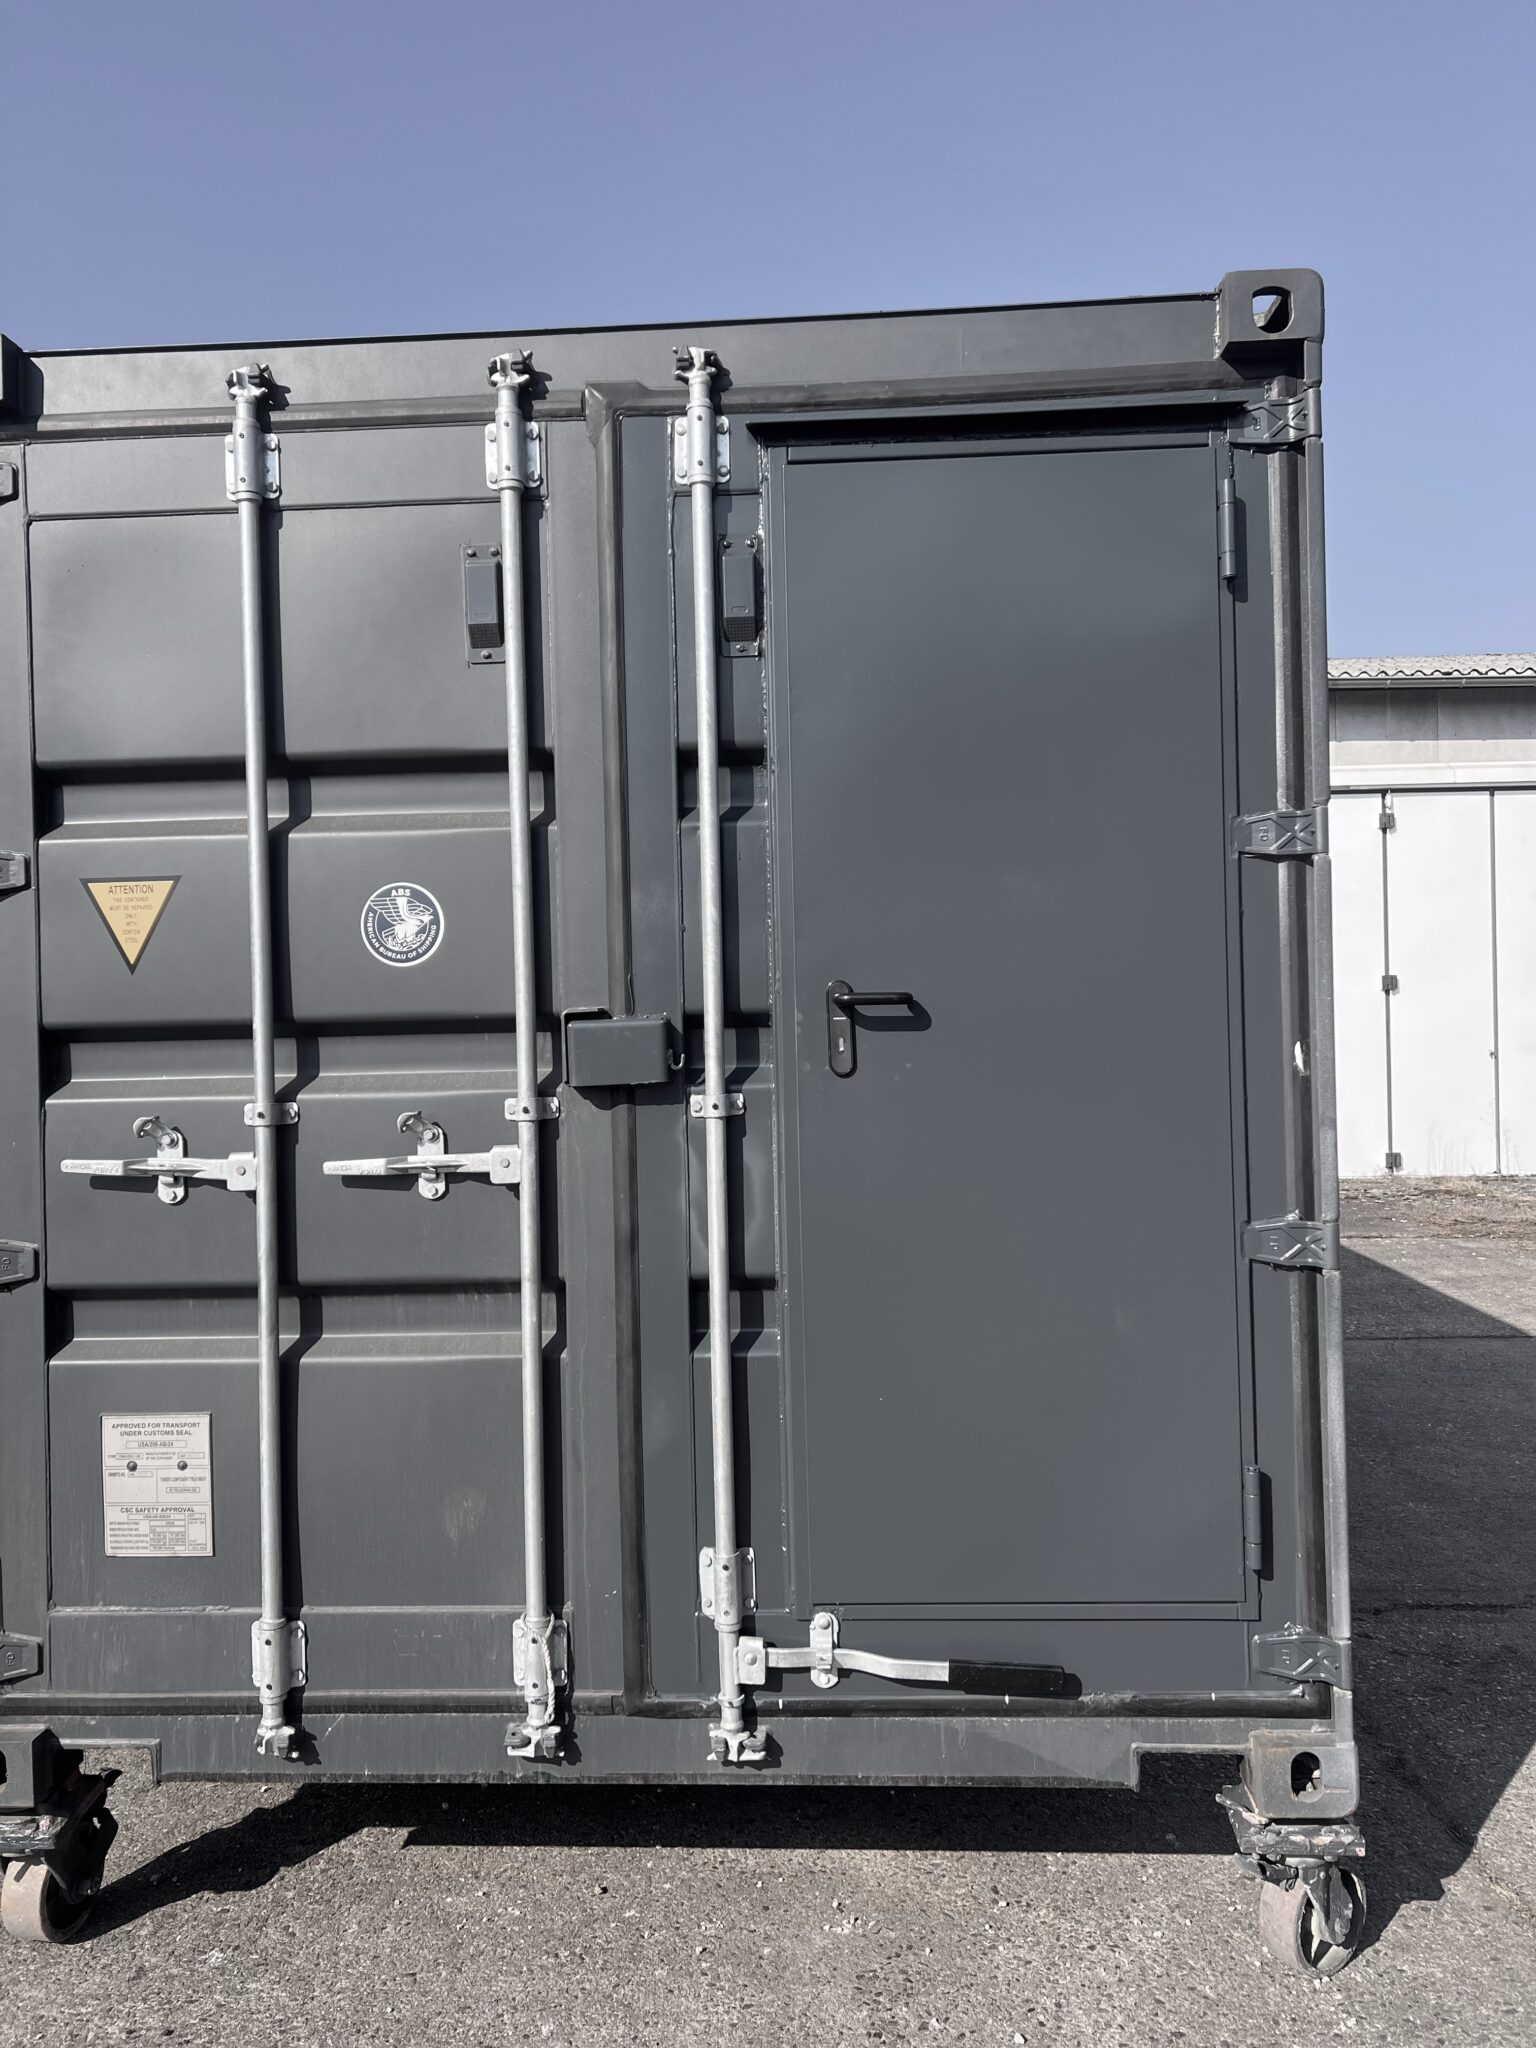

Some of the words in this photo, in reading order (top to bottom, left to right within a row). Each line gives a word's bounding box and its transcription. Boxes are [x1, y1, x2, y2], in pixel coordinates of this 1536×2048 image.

[108, 884, 154, 894] ATTENTION
[391, 888, 411, 896] ABS
[366, 912, 379, 948] AMERICAN
[378, 946, 407, 960] BUREAU
[408, 951, 418, 959] OF
[418, 924, 437, 954] SHIPPING
